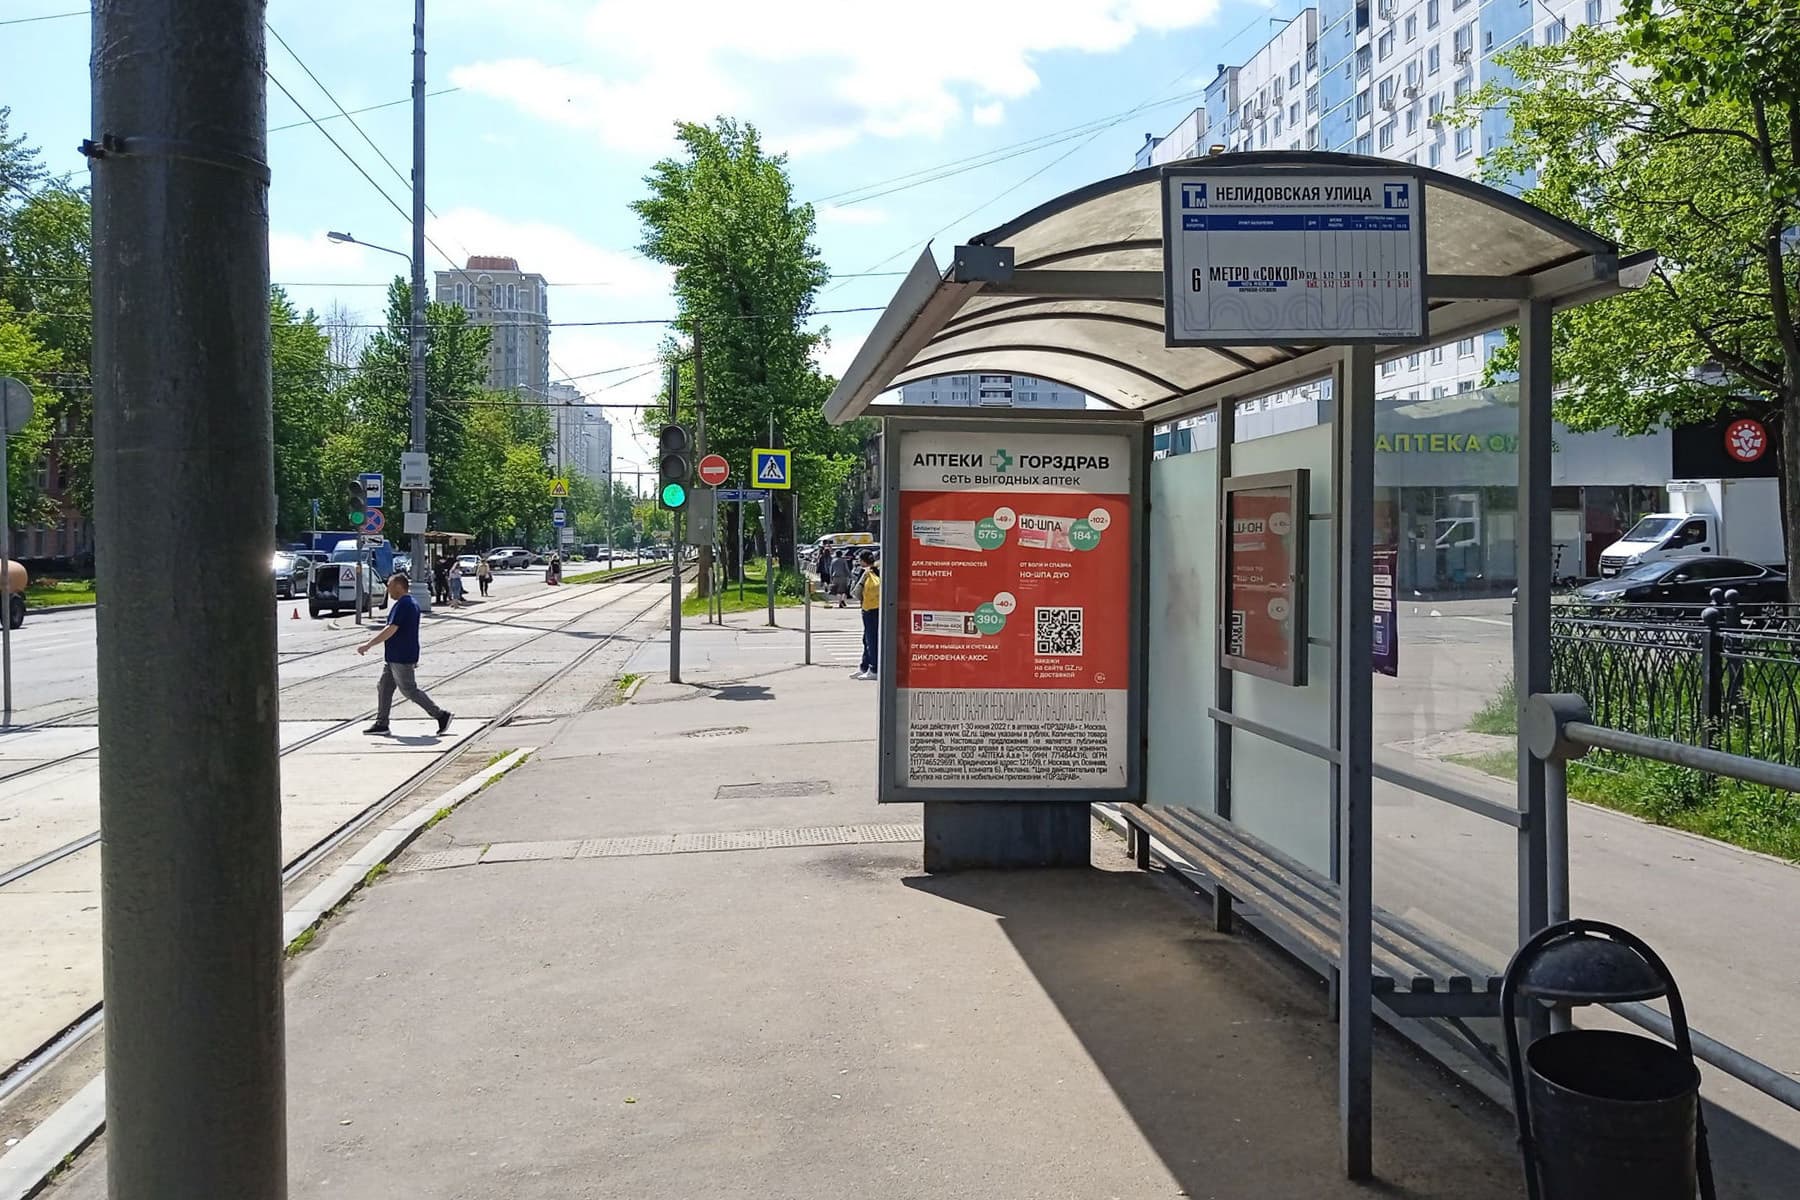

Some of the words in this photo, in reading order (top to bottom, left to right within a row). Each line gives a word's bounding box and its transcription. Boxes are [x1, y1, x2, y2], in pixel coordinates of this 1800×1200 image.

[1216, 187, 1320, 203] НЕЛИДОВСКАЯ
[1324, 187, 1373, 203] УЛИЦА
[1192, 268, 1201, 292] 6
[1209, 267, 1249, 281] МЕТРО
[1253, 267, 1305, 281] «СОКОЛ»
[1375, 433, 1481, 452] АПТЕКА
[912, 453, 983, 467] АПТЕКИ
[1019, 455, 1110, 471] ГОРЗДРАВ
[942, 474, 972, 484] сеть
[974, 475, 1039, 486] выгодных
[1042, 475, 1081, 486] аптек
[1020, 518, 1062, 532] НО-ШПА
[978, 530, 998, 539] 575
[1072, 530, 1091, 540] 184
[977, 614, 998, 624] 390
[912, 654, 989, 662] ДИКЛОФЕНАК-АКОС
[910, 723, 929, 731] Акция
[990, 723, 1006, 731] 2022
